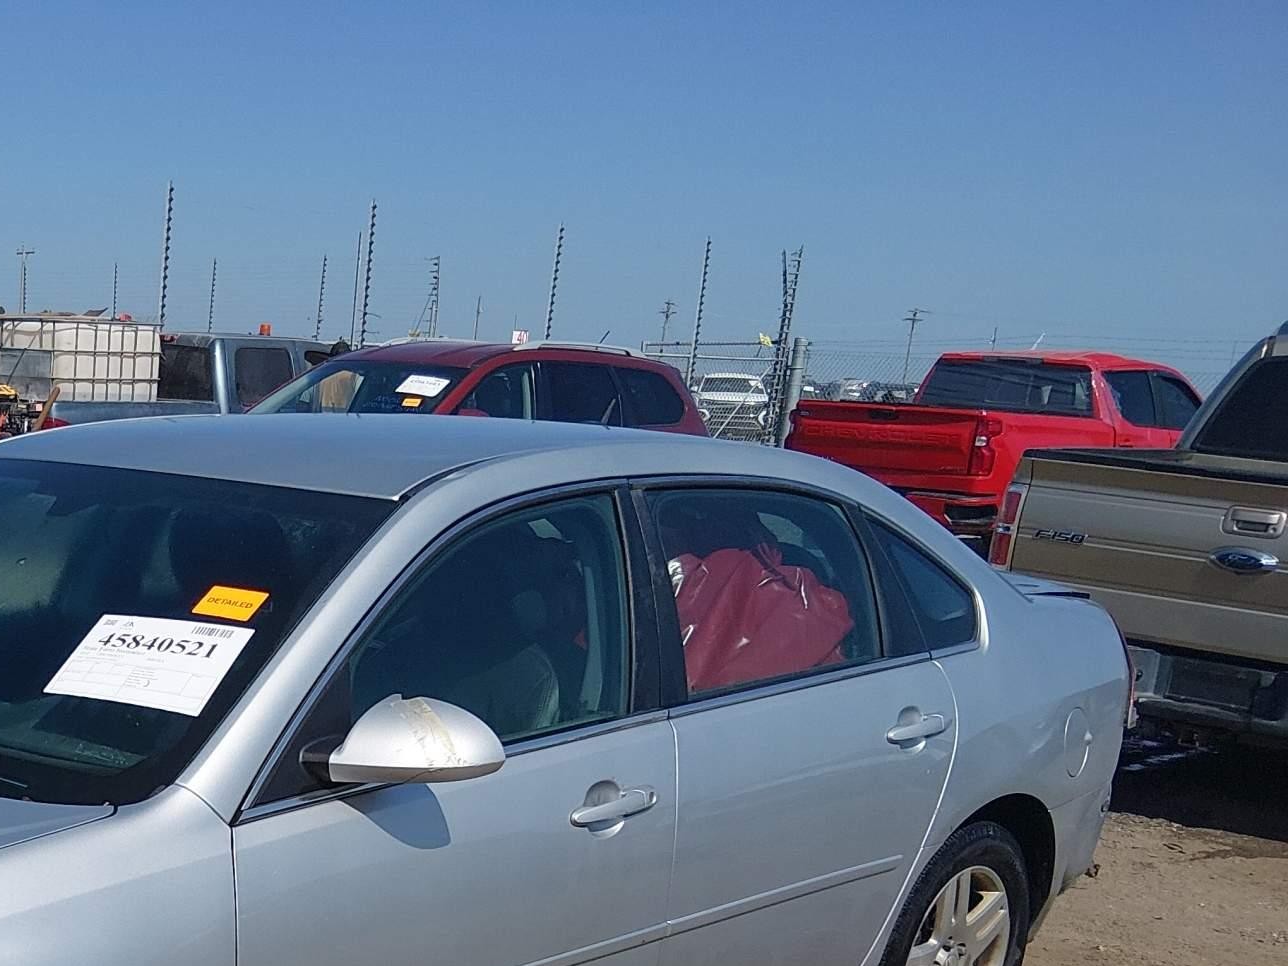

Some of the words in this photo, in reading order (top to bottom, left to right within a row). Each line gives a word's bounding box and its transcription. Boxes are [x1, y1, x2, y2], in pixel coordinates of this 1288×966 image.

[806, 423, 961, 444] CHEVROLET
[207, 596, 253, 609] DETAILED
[98, 632, 218, 658] 45840521
